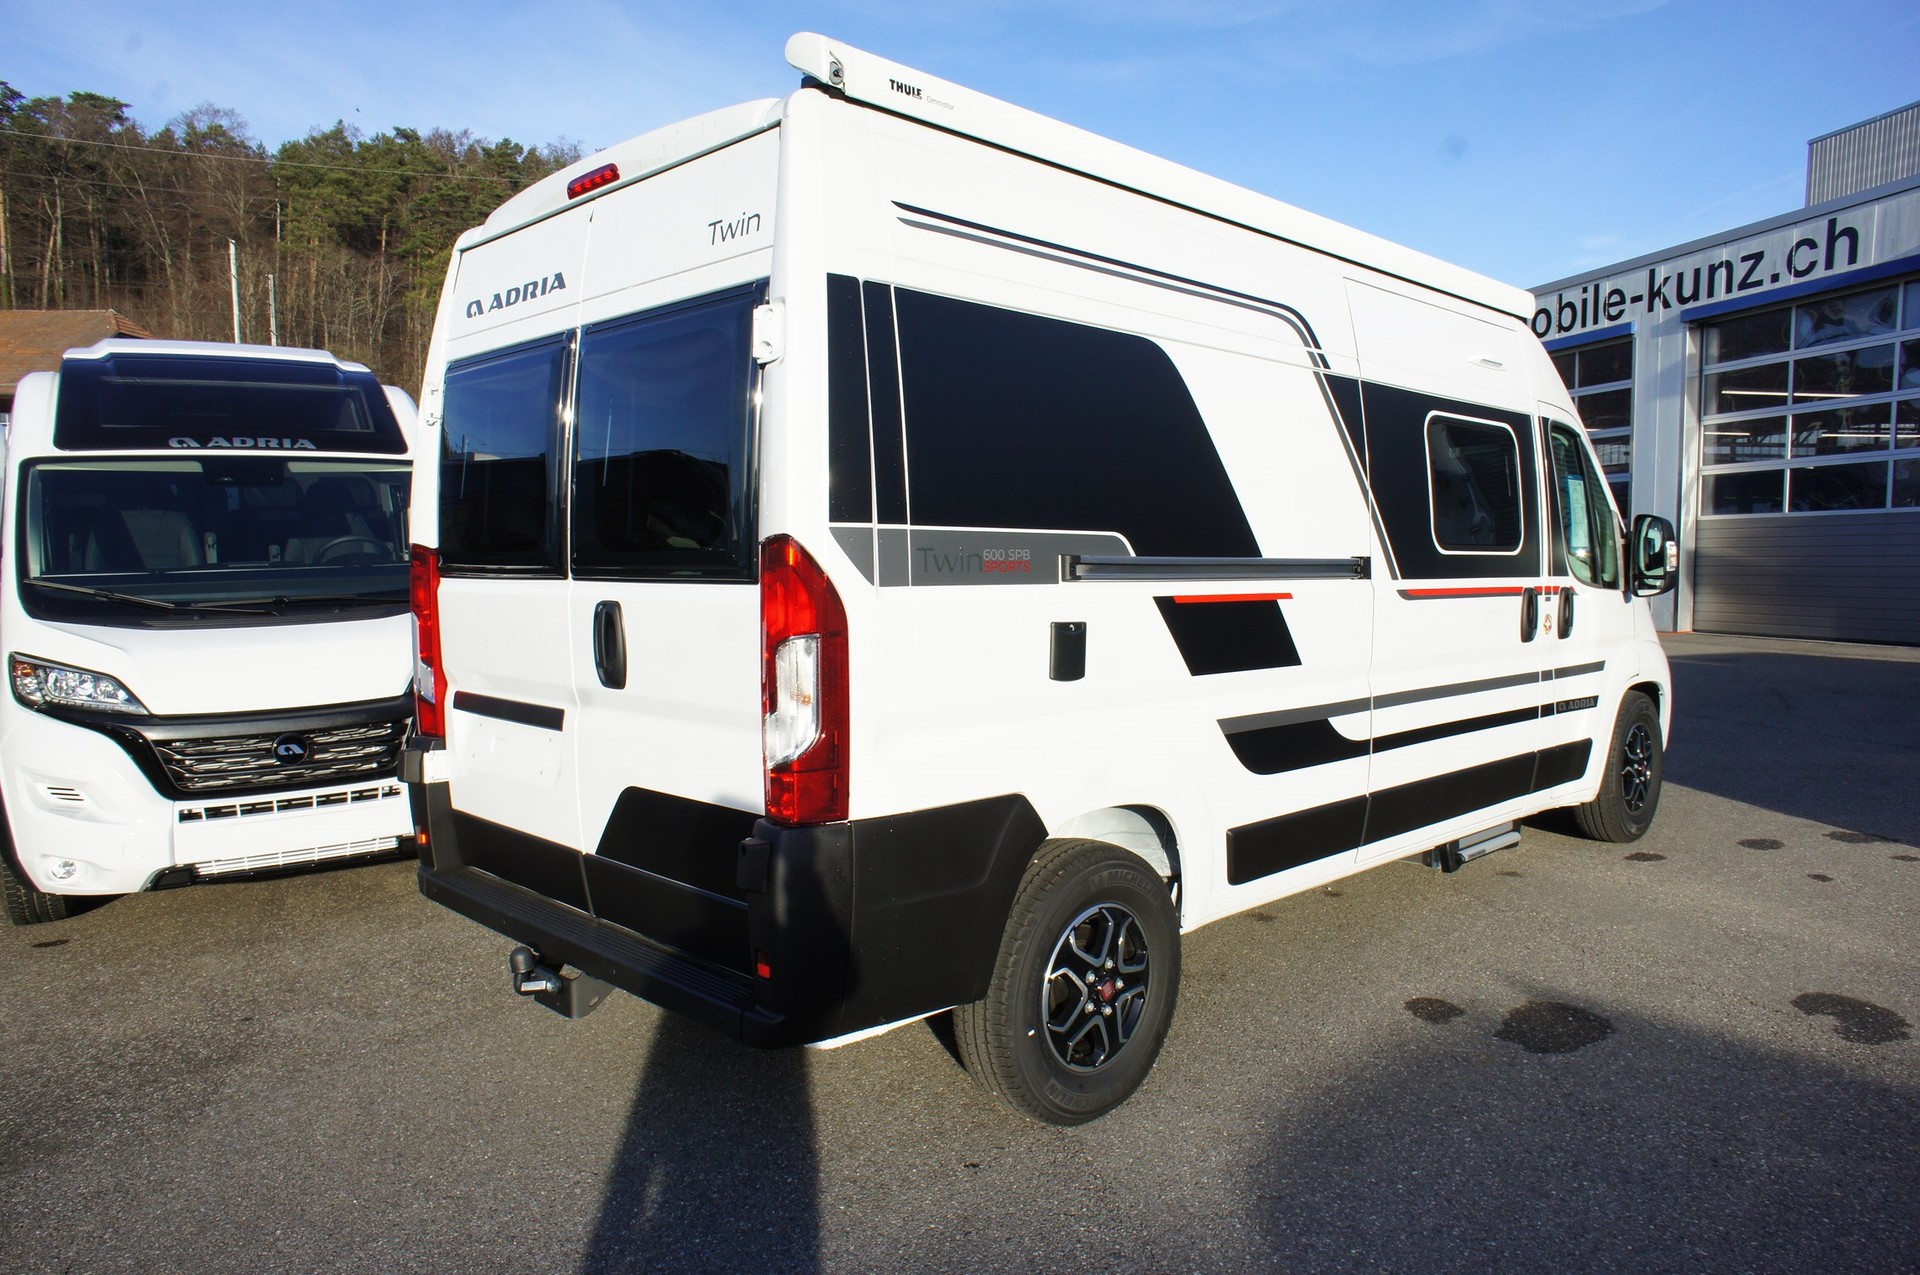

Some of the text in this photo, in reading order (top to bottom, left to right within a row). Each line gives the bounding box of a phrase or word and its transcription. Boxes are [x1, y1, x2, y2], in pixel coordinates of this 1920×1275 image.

[889, 78, 955, 111] THULE Omnistor
[708, 211, 761, 246] Twin
[487, 271, 567, 314] ADRIA
[1522, 217, 1859, 339] obile-kunz.ch
[206, 436, 318, 450] ADRIA
[915, 546, 1032, 573] Twin 600 SPB
[983, 561, 1032, 573] SPORTS
[1567, 697, 1596, 710] ADRIA
